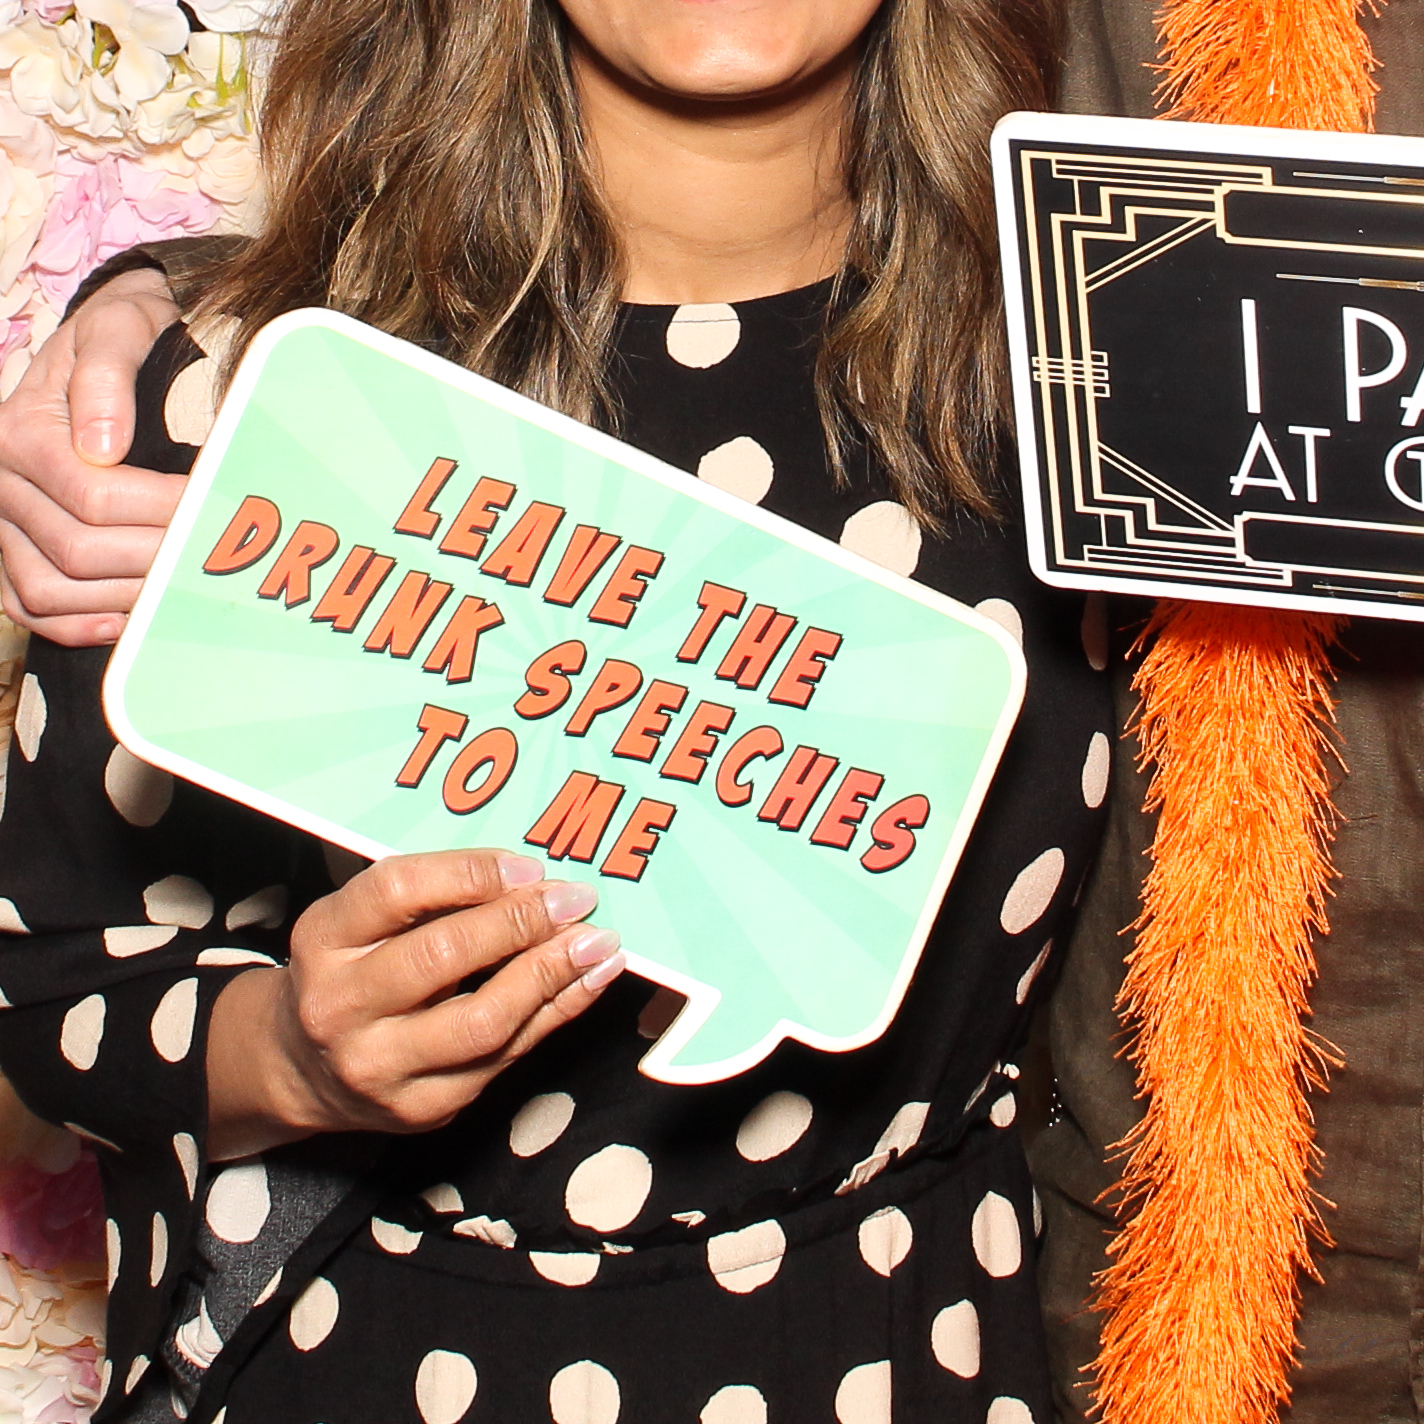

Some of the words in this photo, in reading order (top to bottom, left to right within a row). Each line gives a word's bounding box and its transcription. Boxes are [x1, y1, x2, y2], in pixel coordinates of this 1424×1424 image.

[1241, 299, 1261, 414] I
[1230, 422, 1331, 503] AT
[394, 456, 664, 626] LEAVE
[675, 581, 843, 708] THE
[203, 495, 506, 683] DRUNK
[513, 639, 931, 873] SPEECHES
[396, 703, 518, 815] TO
[524, 770, 677, 882] ME
